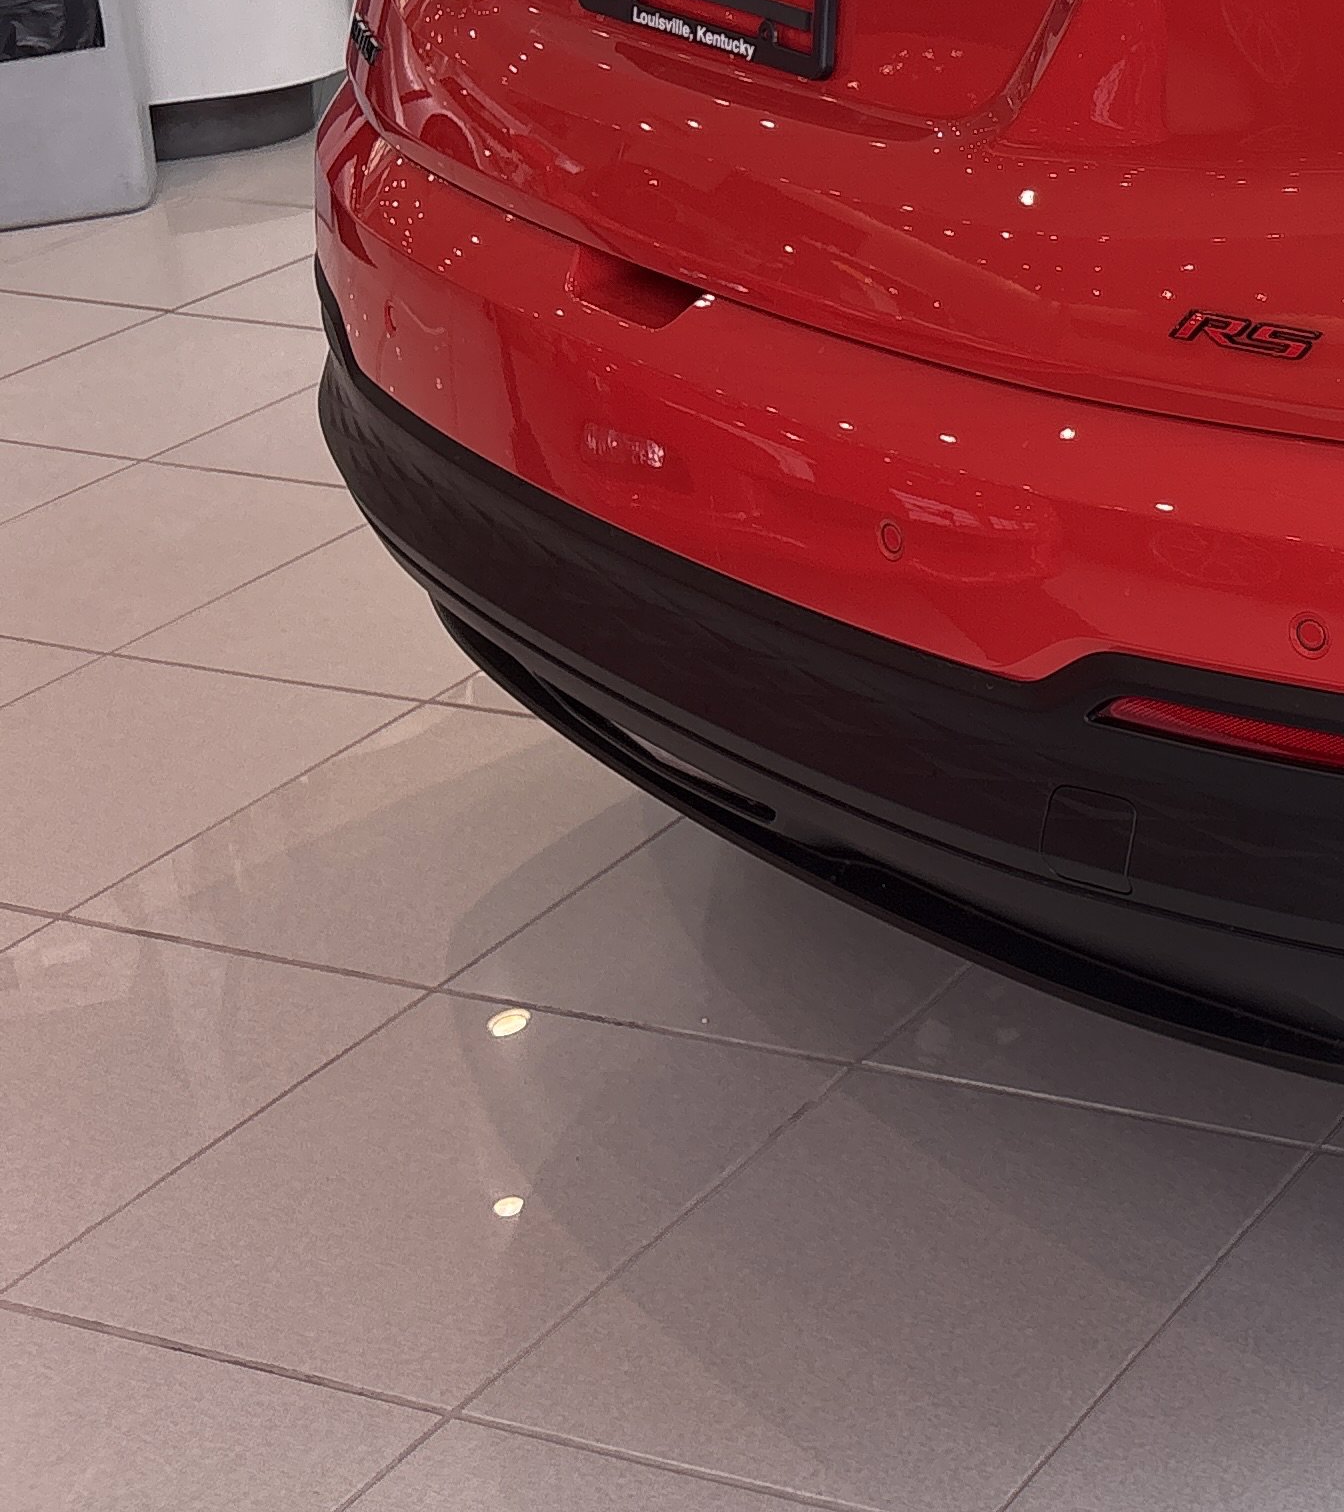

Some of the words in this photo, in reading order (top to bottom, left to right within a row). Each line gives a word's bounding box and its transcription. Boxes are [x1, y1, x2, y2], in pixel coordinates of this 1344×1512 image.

[632, 5, 694, 42] Louisville,
[696, 25, 756, 61] Kentucky
[1167, 308, 1324, 361] RS
